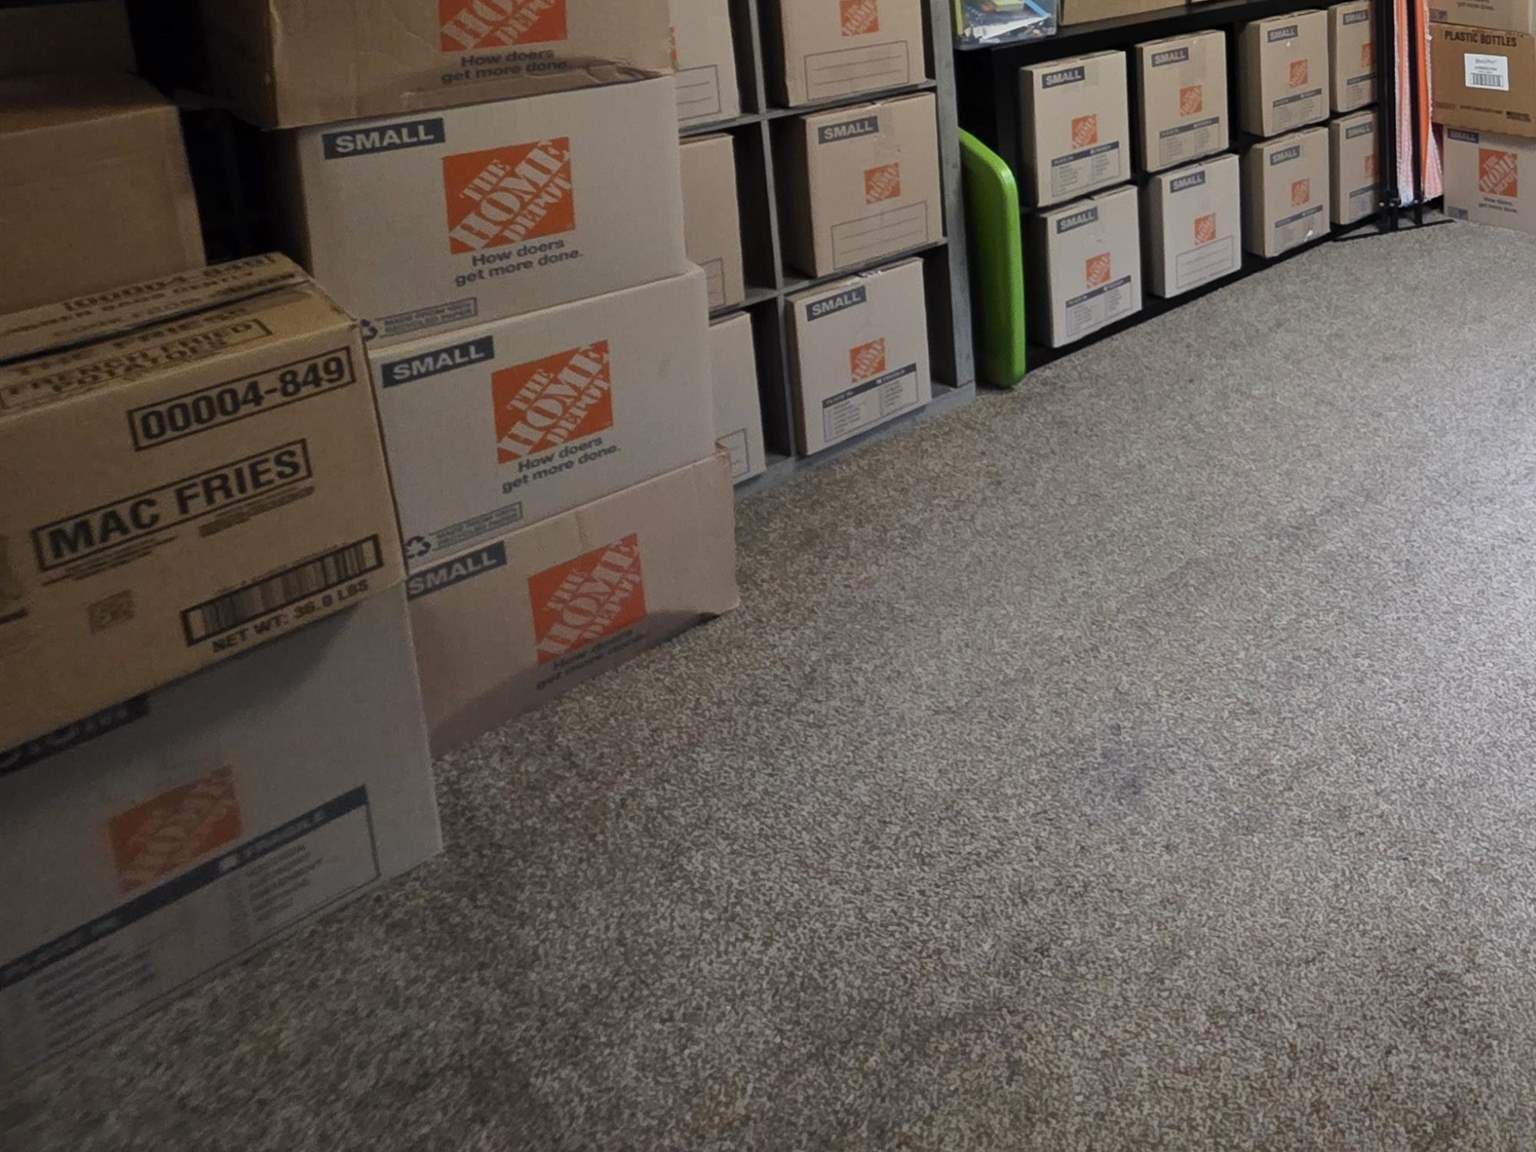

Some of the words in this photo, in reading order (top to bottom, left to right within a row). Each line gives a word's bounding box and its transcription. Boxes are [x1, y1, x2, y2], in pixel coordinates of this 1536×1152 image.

[1444, 30, 1478, 43] PLASTIC
[1481, 35, 1517, 48] BOTTLES
[441, 70, 470, 85] get
[475, 65, 520, 78] more
[461, 54, 501, 66] How
[505, 49, 555, 62] doers
[1046, 70, 1082, 86] SMALL
[335, 124, 435, 153] SMALL
[824, 120, 874, 140] SMALL
[448, 141, 569, 248] HOME
[458, 159, 512, 201] THE
[502, 173, 572, 242] DEPOT
[472, 249, 512, 267] How
[517, 239, 565, 258] doers
[454, 268, 486, 287] get
[489, 259, 534, 277] more
[812, 291, 861, 316] SMALL
[393, 346, 485, 381] SMALL
[141, 355, 347, 440] 00004-849
[497, 347, 609, 456] HOME
[506, 368, 554, 411] THE
[546, 374, 610, 445] DEPOT
[517, 455, 555, 473] How
[558, 437, 603, 459] doers
[501, 474, 528, 494] get
[532, 459, 575, 481] more
[50, 500, 161, 560] MAC
[175, 449, 301, 515] FRIES
[406, 550, 497, 594] SMALL
[535, 540, 638, 653] HOME
[212, 628, 249, 653] NET
